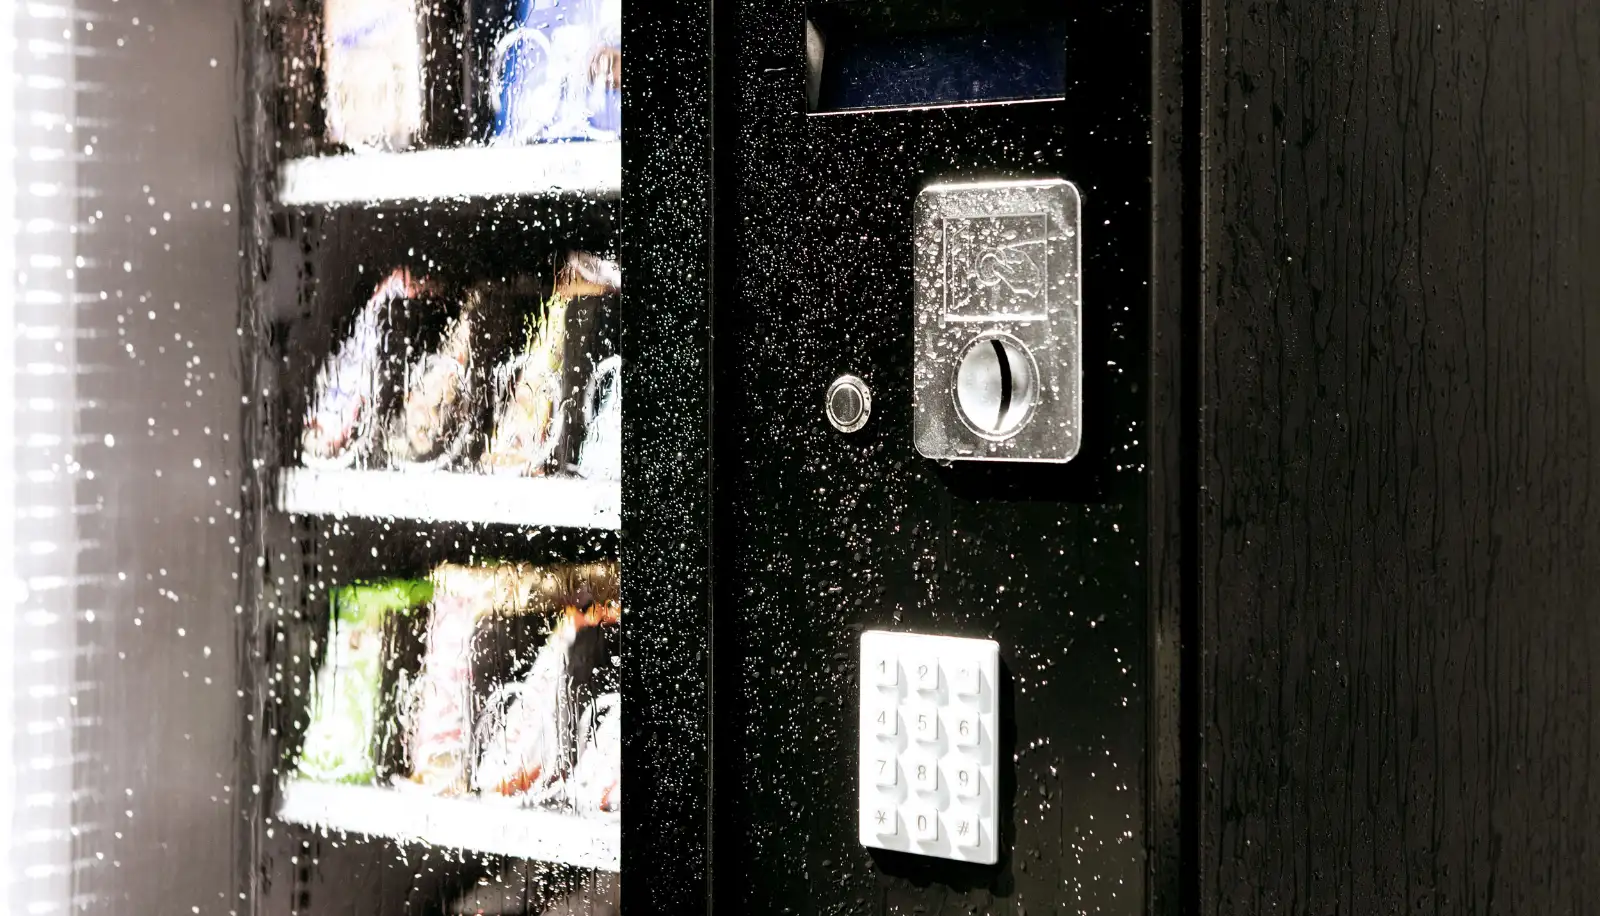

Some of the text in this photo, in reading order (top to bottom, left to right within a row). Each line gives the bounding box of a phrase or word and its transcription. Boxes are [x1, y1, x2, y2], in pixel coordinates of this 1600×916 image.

[877, 659, 928, 681] 1 2
[876, 710, 970, 736] 4 5 6
[876, 759, 969, 786] 7 8 9
[917, 814, 928, 832] 0
[957, 820, 970, 837] #
